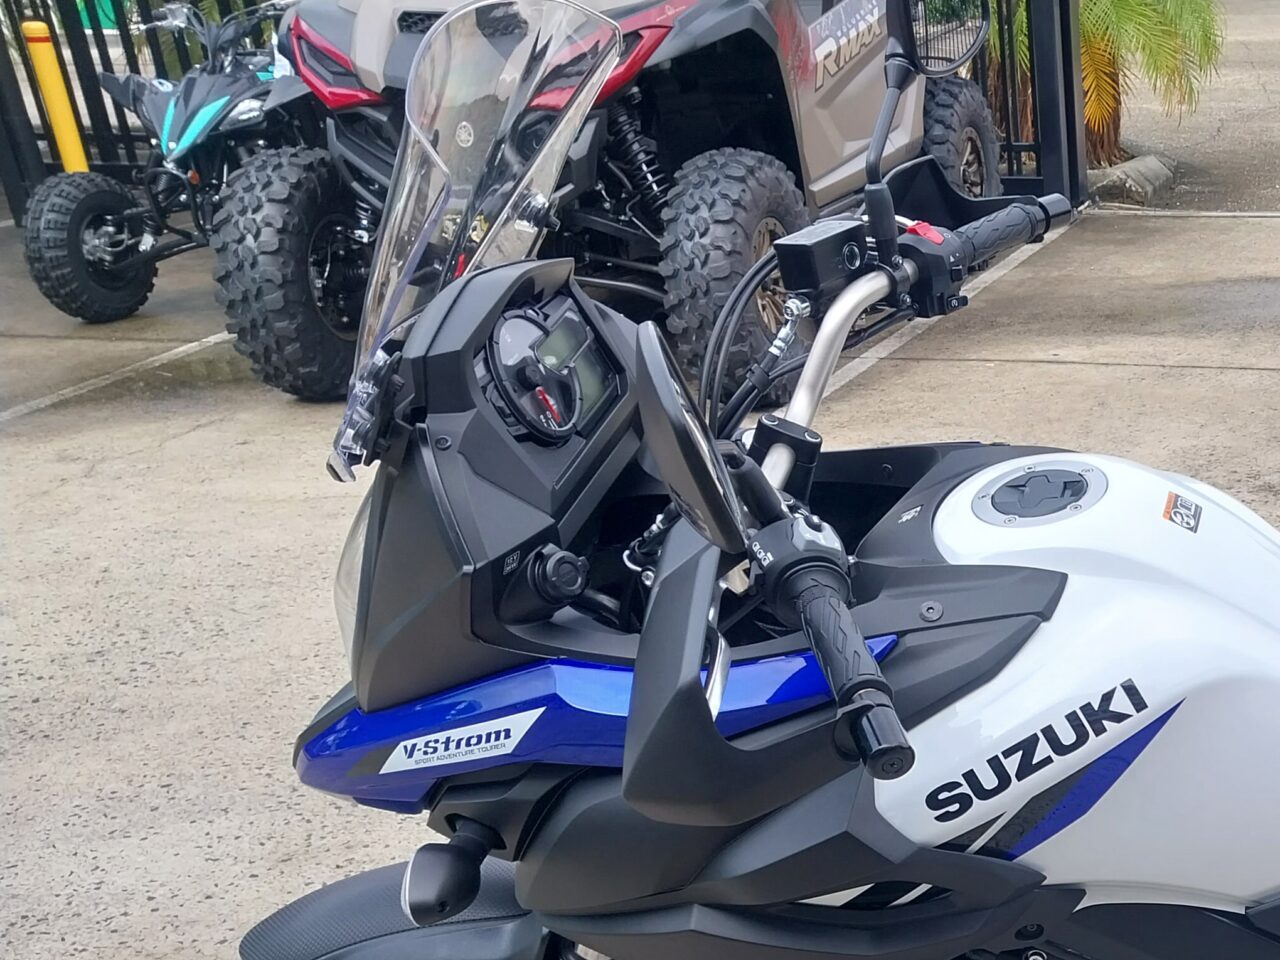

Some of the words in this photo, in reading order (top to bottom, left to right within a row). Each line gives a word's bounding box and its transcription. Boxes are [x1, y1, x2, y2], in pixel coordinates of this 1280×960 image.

[403, 727, 512, 759] V-Strom
[414, 756, 436, 766] SPORT
[436, 749, 476, 762] ADVENTURE
[477, 743, 507, 755] TOURER
[925, 678, 1149, 823] SUZUKI
